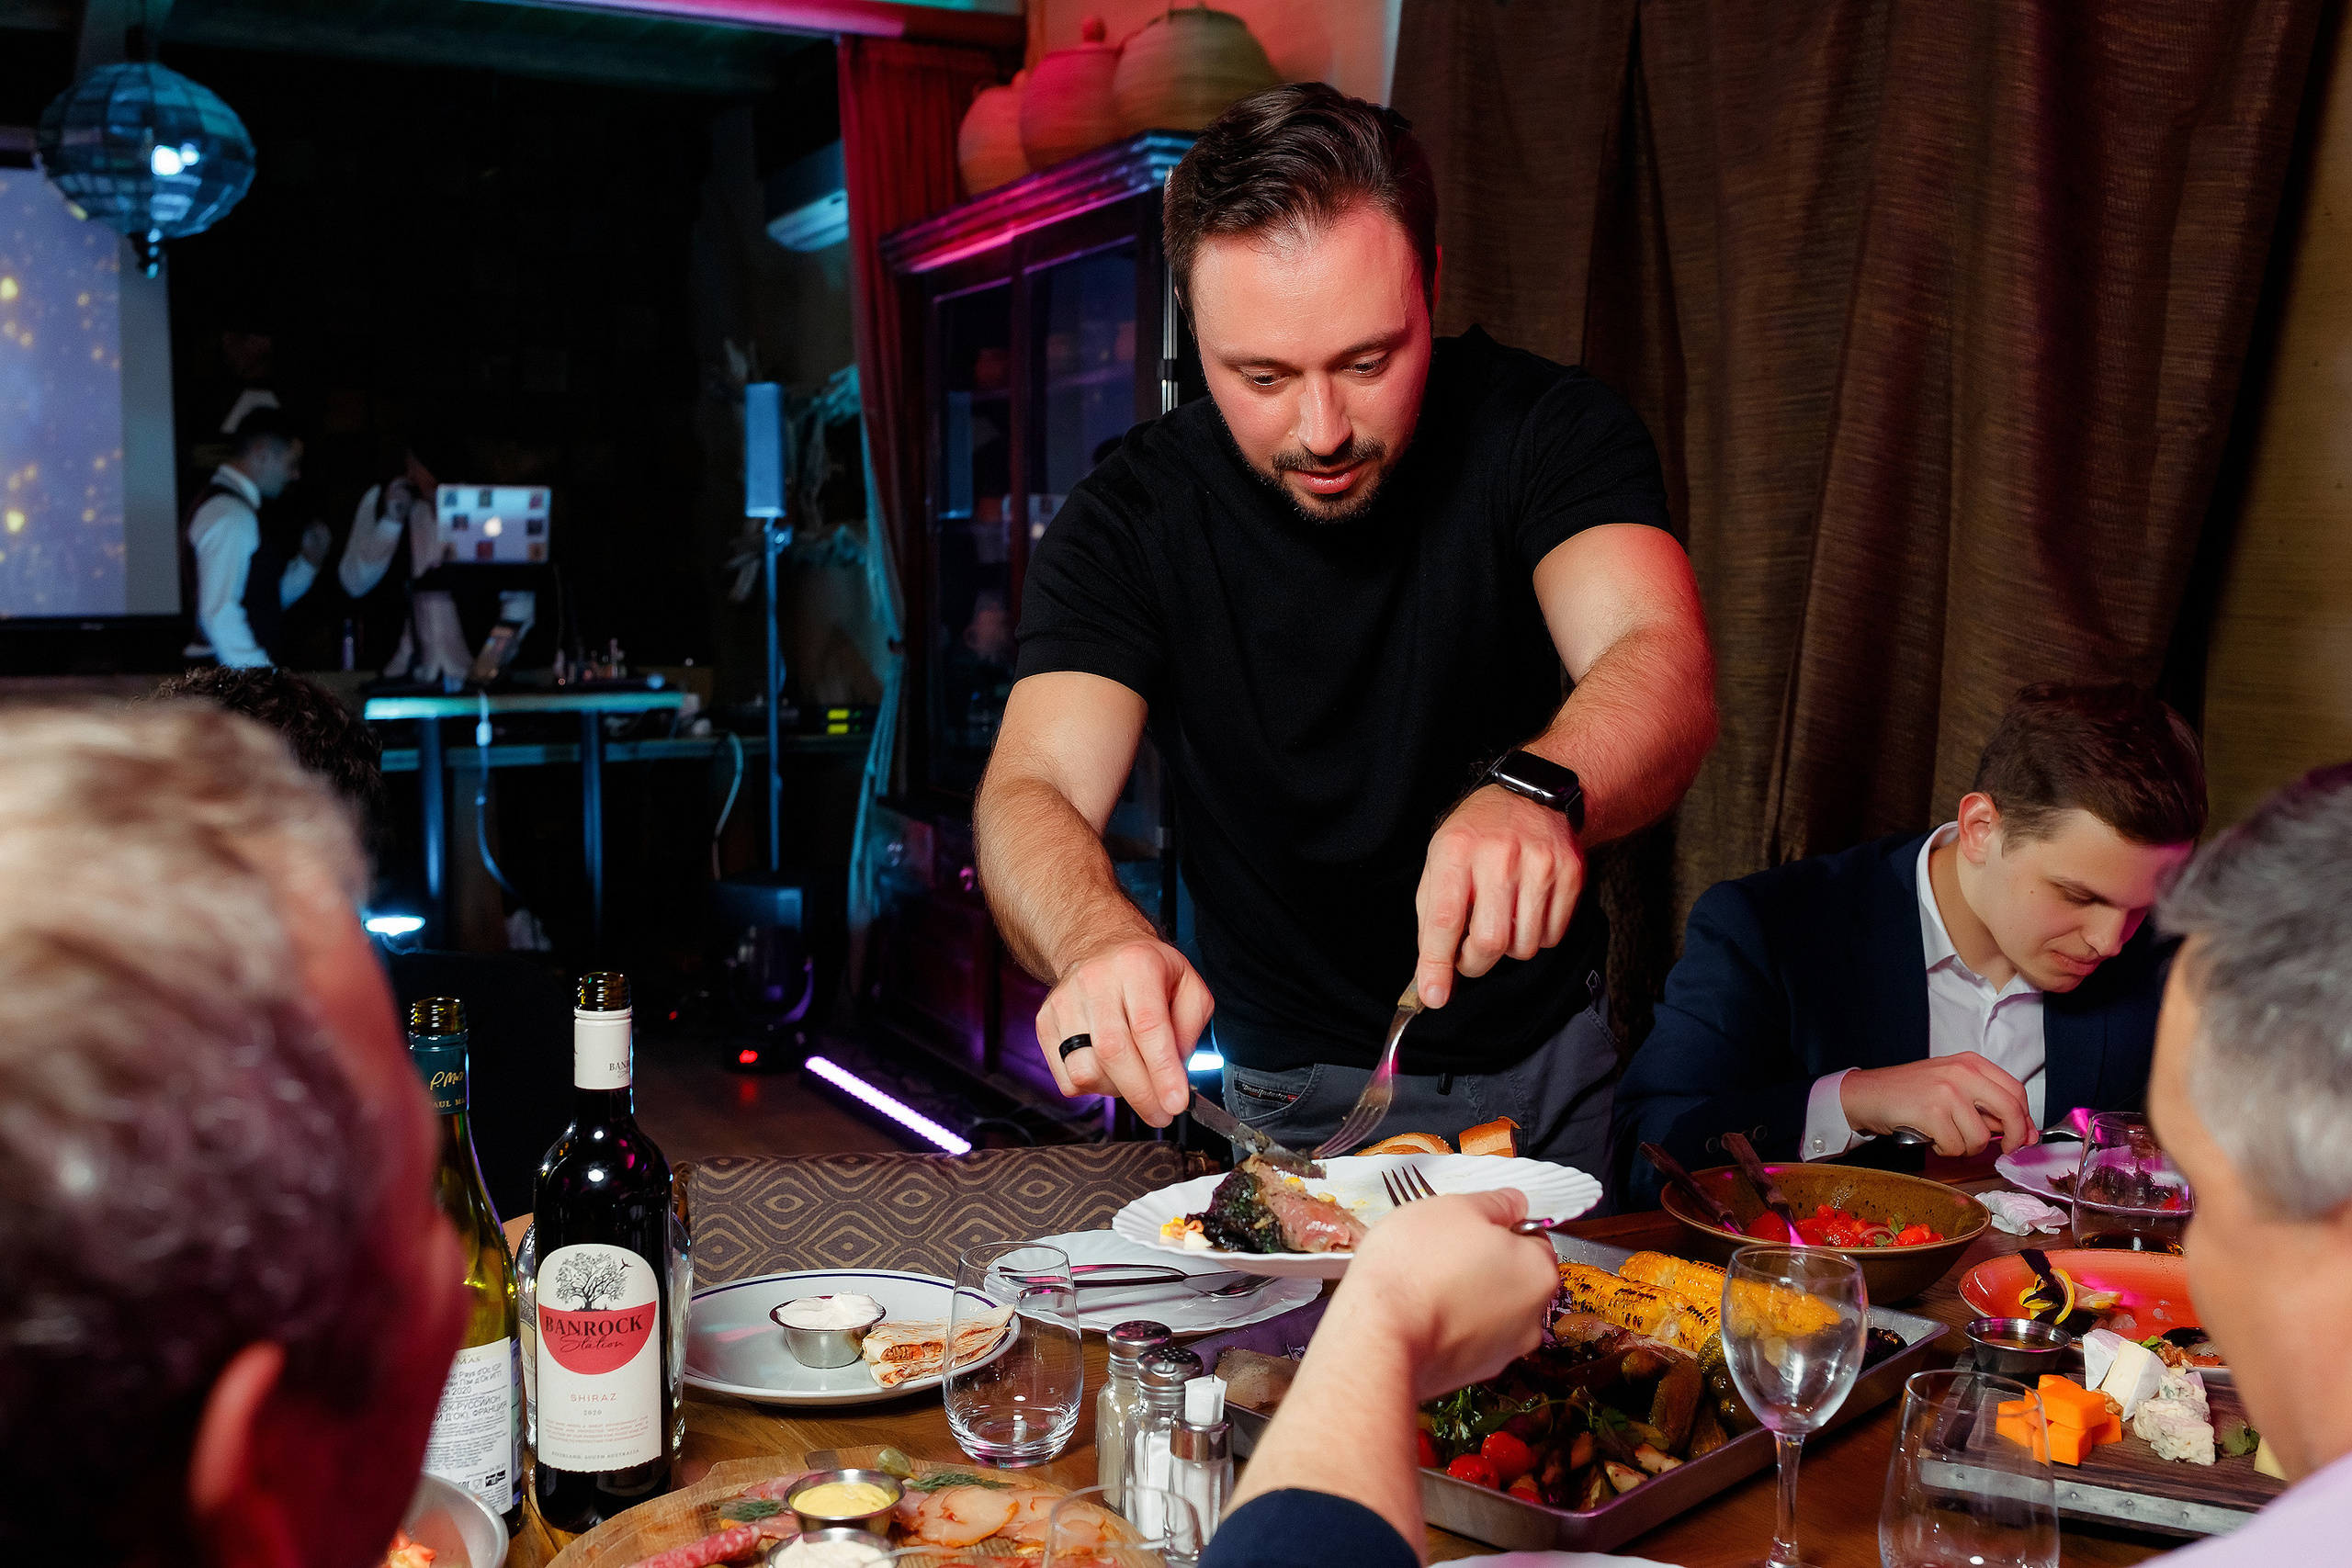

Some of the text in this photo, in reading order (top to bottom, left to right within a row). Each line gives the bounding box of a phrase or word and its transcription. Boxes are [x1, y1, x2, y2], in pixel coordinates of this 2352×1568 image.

[546, 1314, 642, 1337] BANROCK
[560, 1332, 626, 1353] Station
[452, 1386, 471, 1395] 2020
[571, 1393, 616, 1403] SHIRAZ
